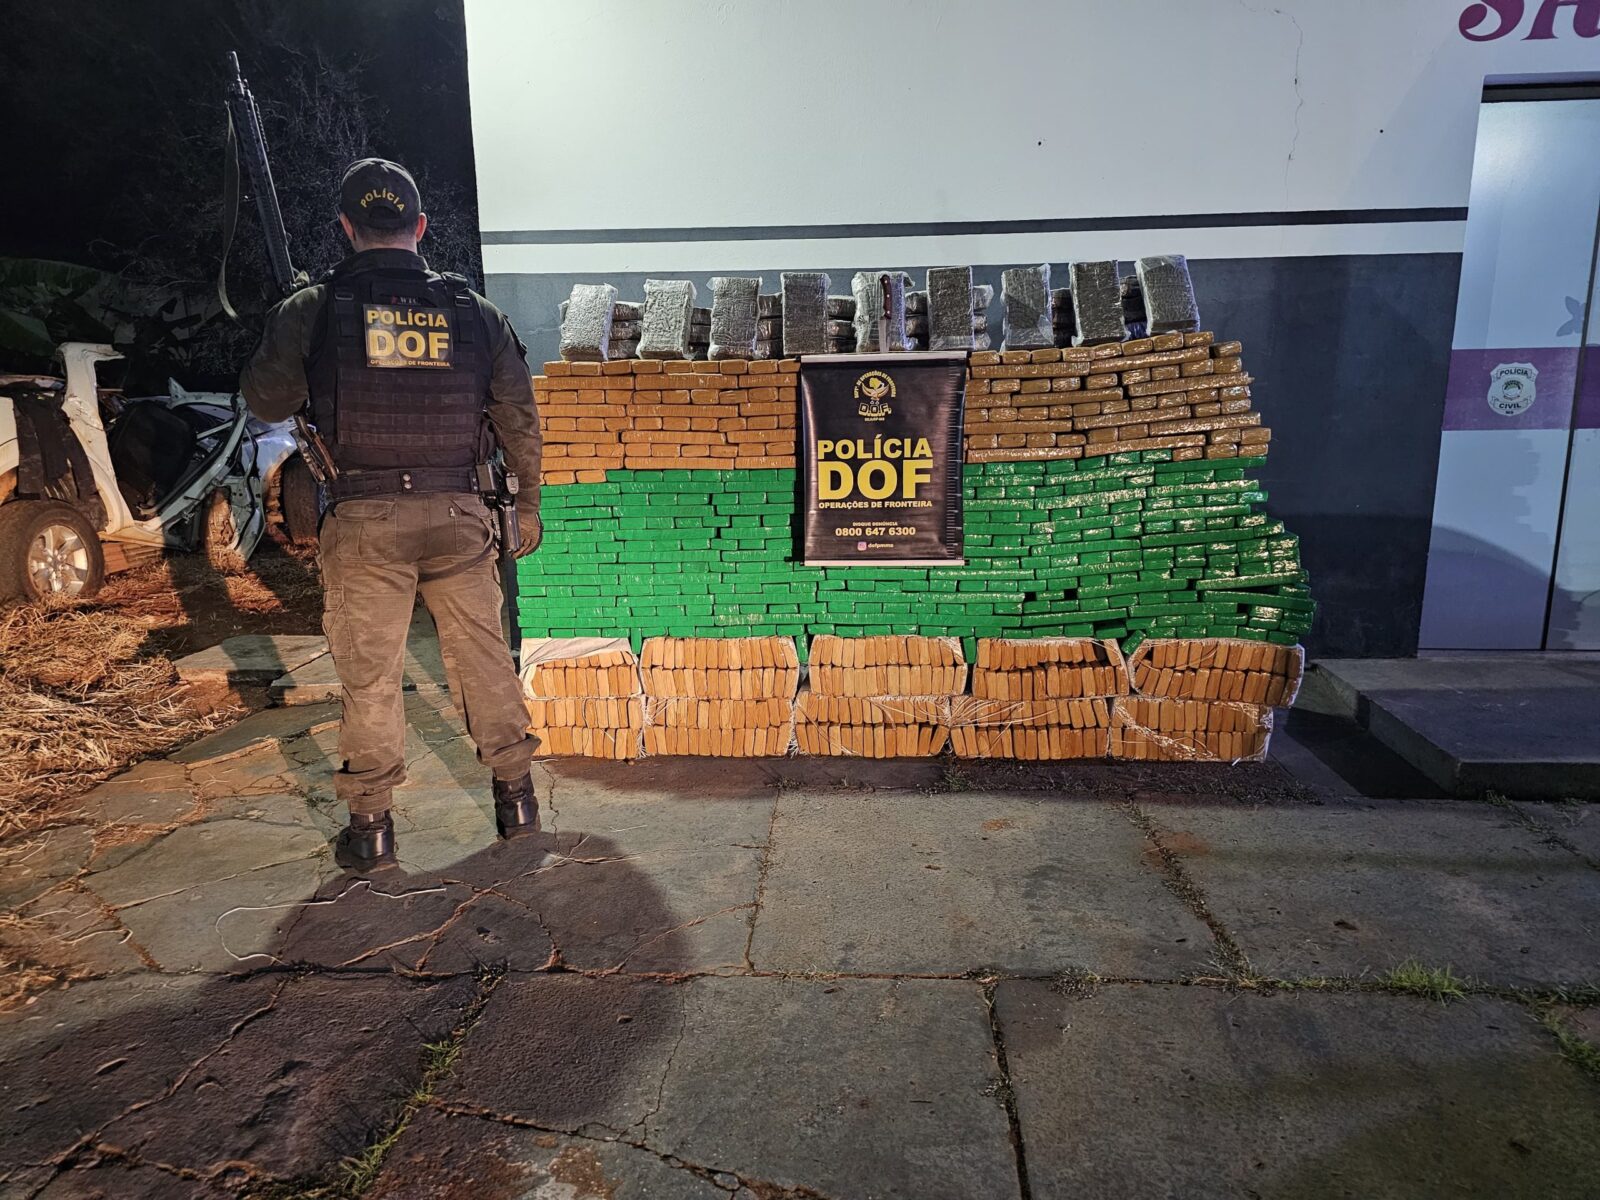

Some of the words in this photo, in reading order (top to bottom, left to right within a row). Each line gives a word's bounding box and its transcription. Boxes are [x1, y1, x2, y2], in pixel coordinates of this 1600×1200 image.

[360, 188, 405, 212] POLÍCIA
[367, 309, 448, 327] POLÍCIA
[368, 329, 450, 359] DOF
[1500, 368, 1528, 376] POLÍCIA
[818, 434, 933, 459] POLÍCIA
[818, 459, 933, 500] DOF
[819, 501, 869, 509] OPERAÇÕES
[885, 500, 932, 508] FRONTEIRA
[835, 528, 862, 536] 0800
[865, 527, 886, 536] 647
[888, 527, 916, 536] 6300
